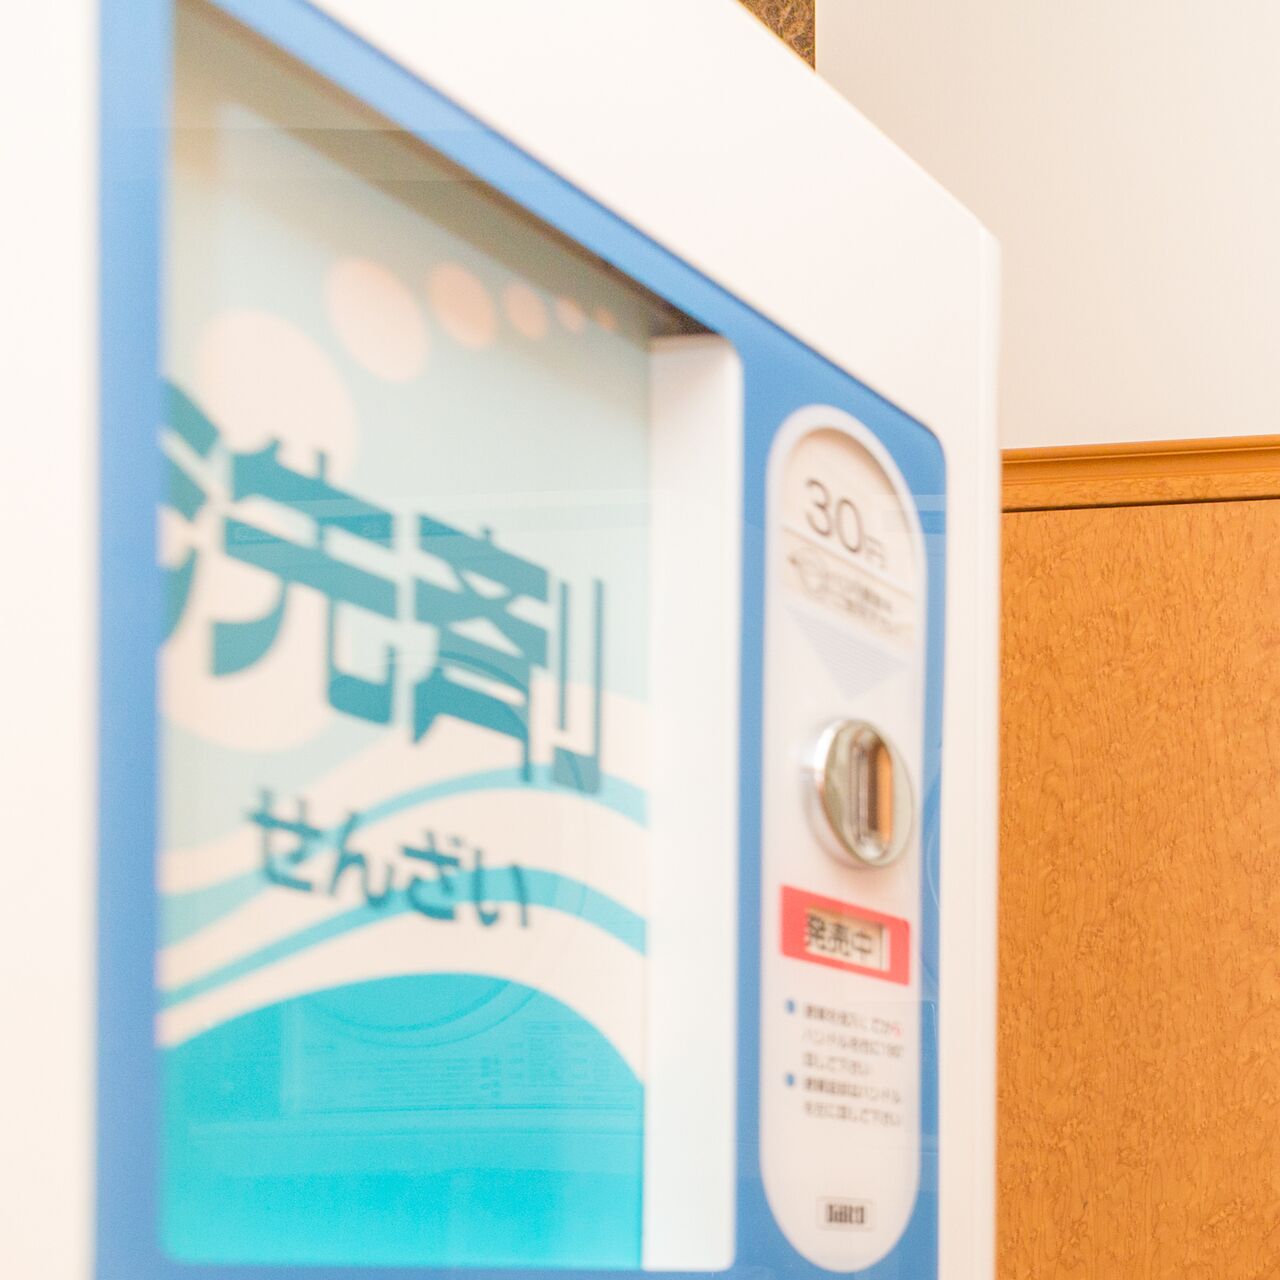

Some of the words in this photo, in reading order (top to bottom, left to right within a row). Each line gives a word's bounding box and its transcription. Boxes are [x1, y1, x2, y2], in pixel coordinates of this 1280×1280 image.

[246, 786, 531, 929] せんざい
[805, 913, 875, 963] 発売中
